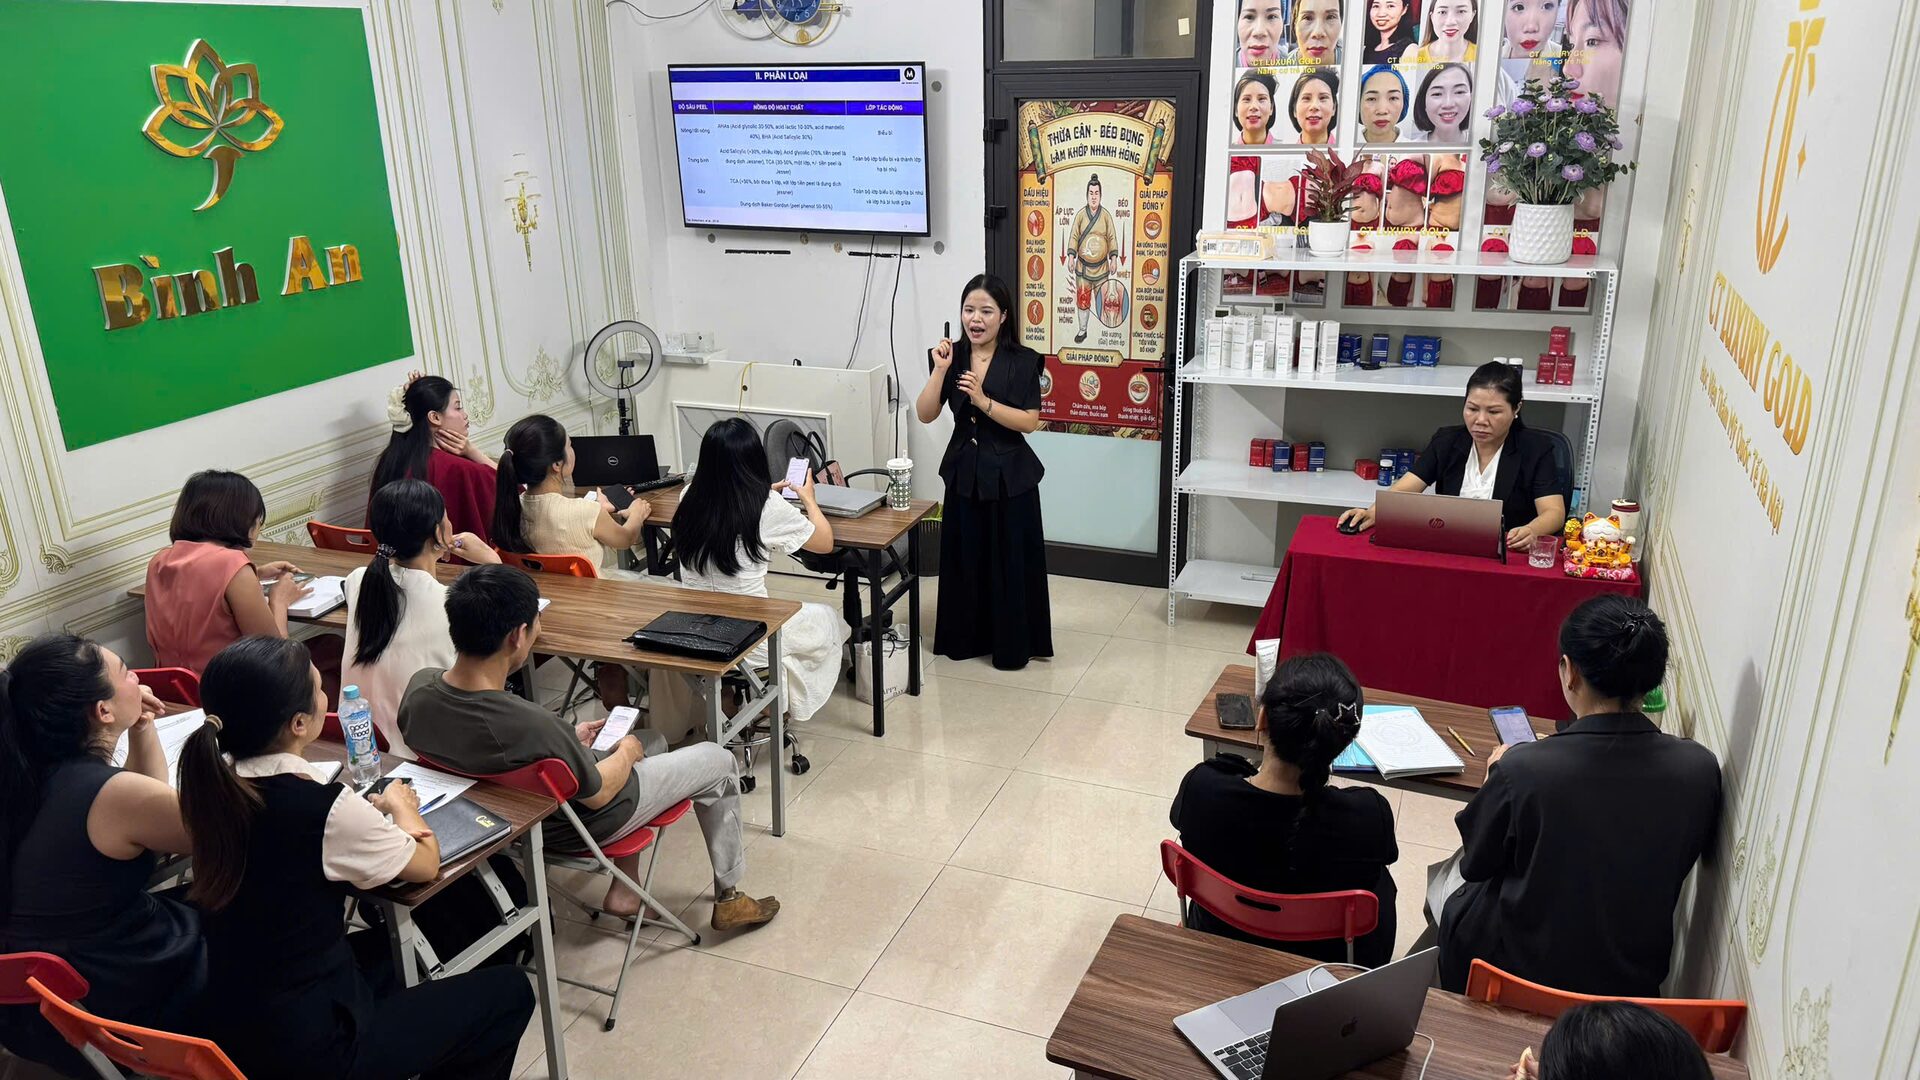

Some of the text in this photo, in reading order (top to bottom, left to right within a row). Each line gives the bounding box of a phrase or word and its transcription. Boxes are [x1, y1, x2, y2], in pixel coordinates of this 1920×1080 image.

[764, 70, 786, 80] PHÂN
[788, 72, 808, 82] LOẠI
[1048, 127, 1071, 146] THỪA
[1074, 122, 1091, 139] CÂN
[1100, 122, 1117, 139] BÉO
[1120, 128, 1144, 147] BỤNG
[1050, 143, 1140, 164] LÀM KHỚP NHANH HỎNG
[1024, 187, 1048, 198] DẤU HIỆU
[1140, 188, 1168, 199] GIẢI PHÁP
[1118, 198, 1128, 208] BÉO
[1143, 200, 1159, 210] ĐÔNG
[1116, 210, 1130, 219] BỤNG
[1360, 226, 1450, 237] CT LUXURY GOLD
[1494, 228, 1508, 237] CT
[92, 235, 364, 331] Bình An
[1066, 351, 1077, 360] GIẢI
[1078, 352, 1093, 362] PHÁP
[1708, 270, 1812, 456] CT LUXURY GOLD
[1750, 448, 1762, 489] Tế
[1757, 463, 1769, 509] Hà
[1767, 480, 1784, 536] Nội
[350, 720, 369, 732] good
[351, 728, 370, 738] mood
